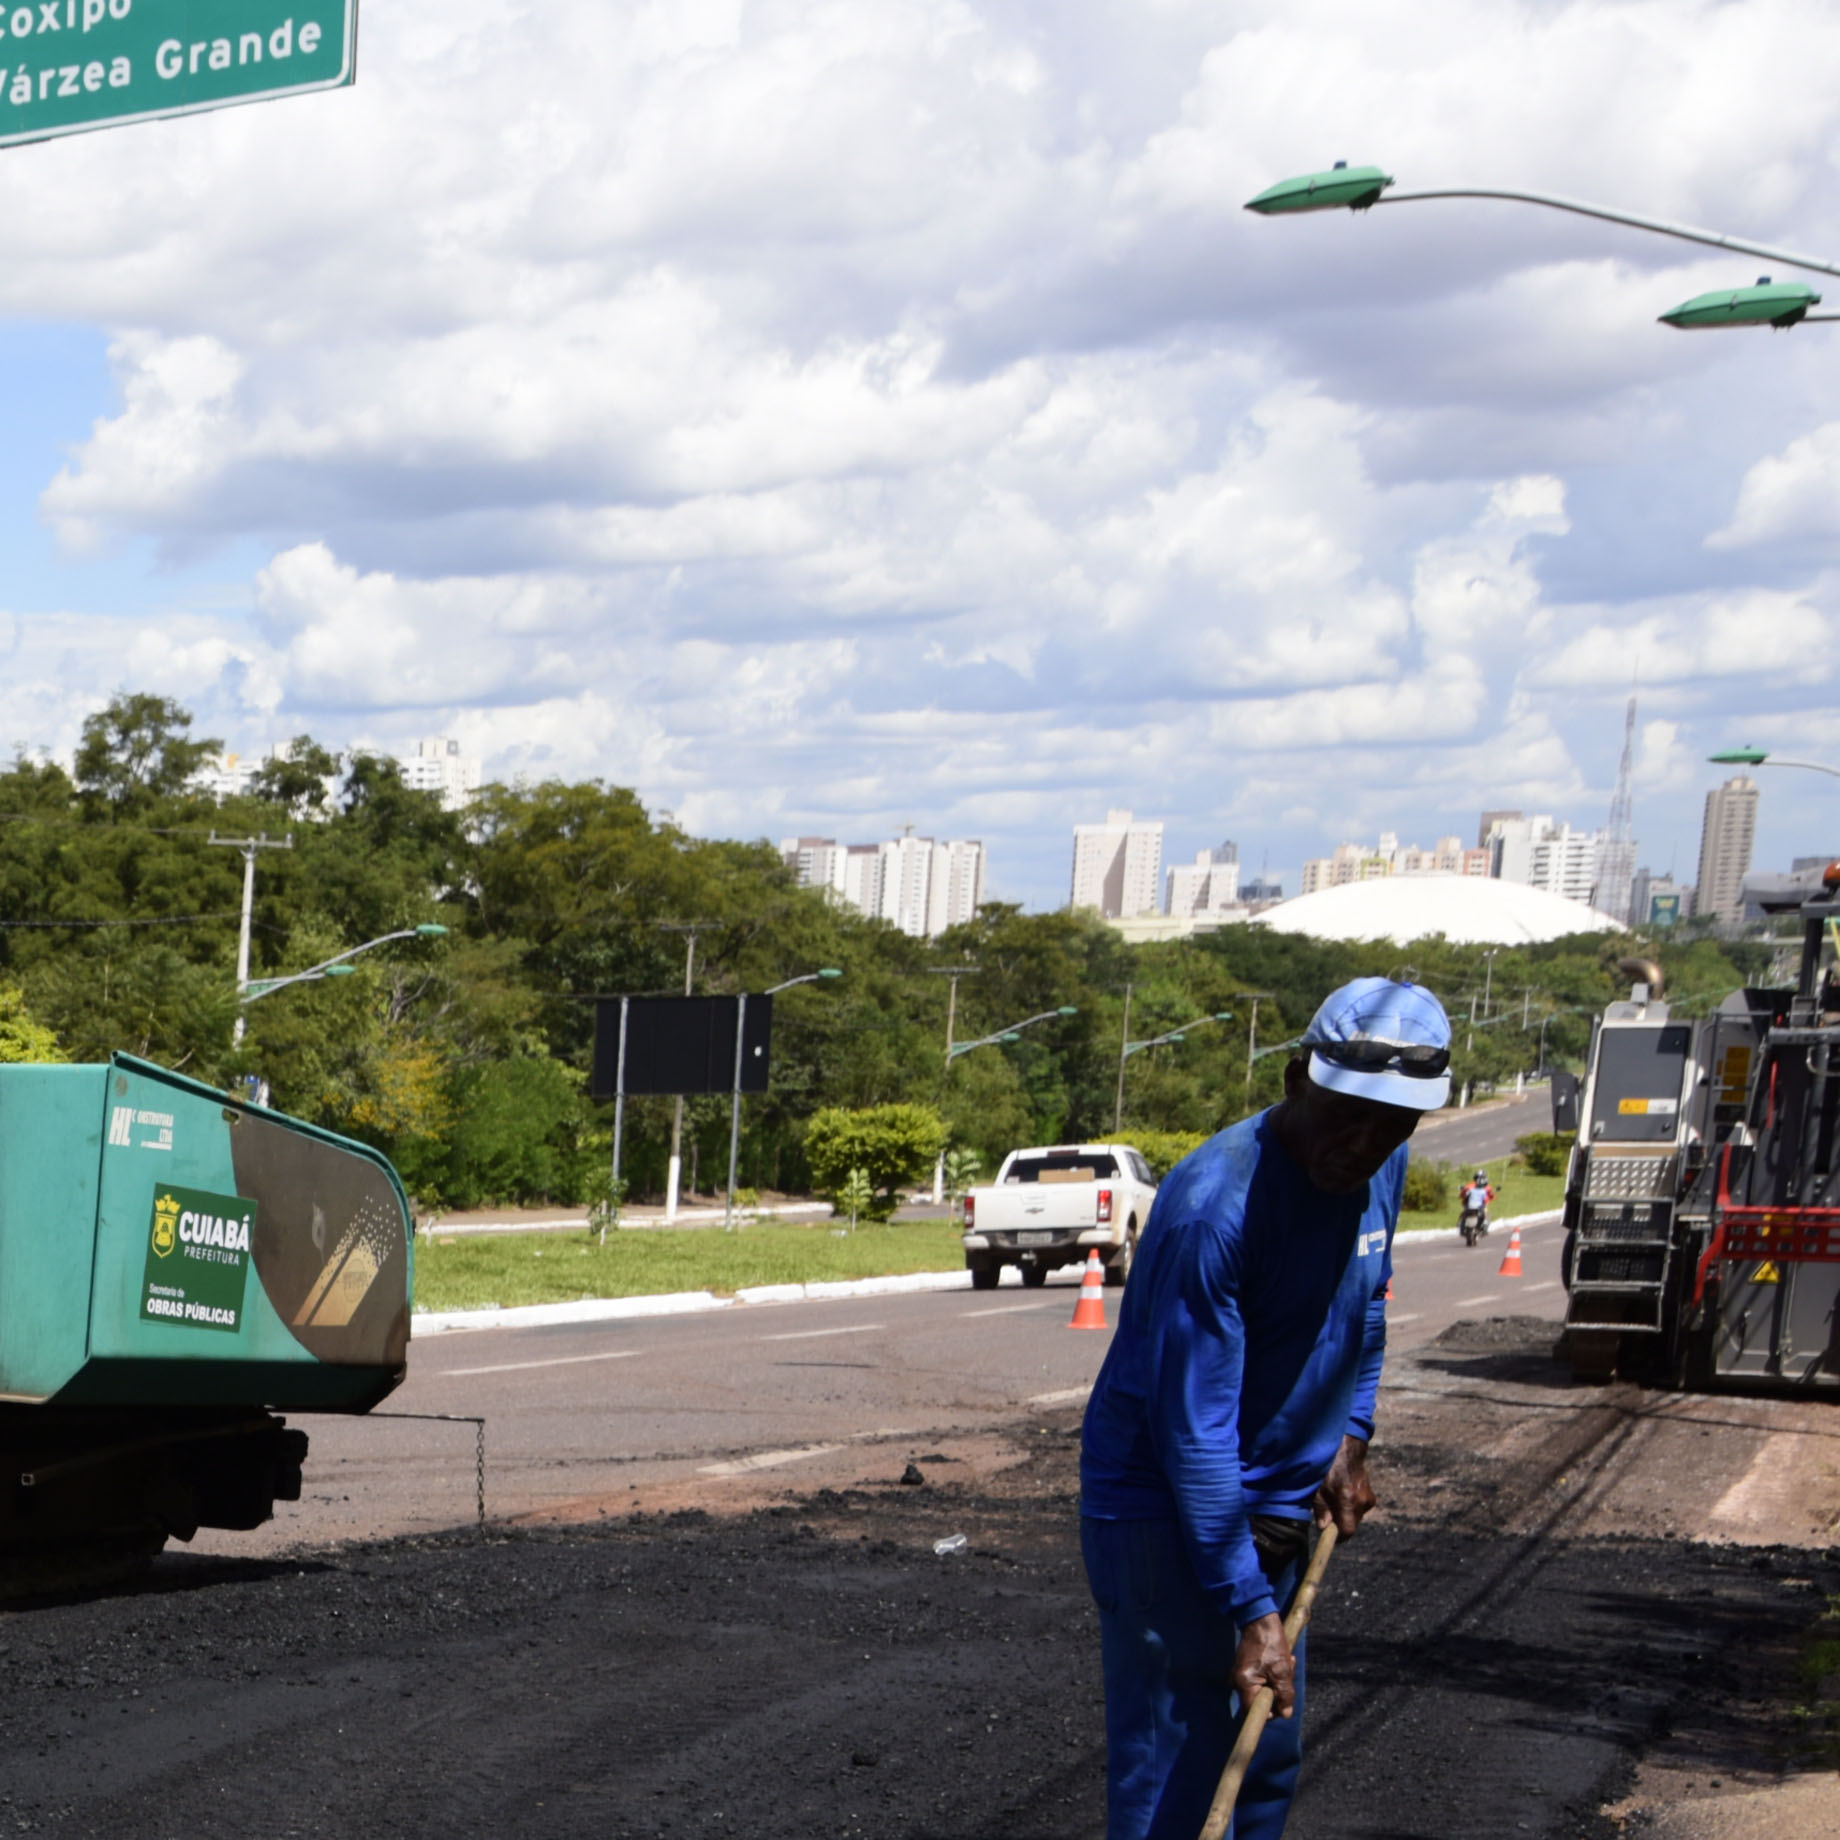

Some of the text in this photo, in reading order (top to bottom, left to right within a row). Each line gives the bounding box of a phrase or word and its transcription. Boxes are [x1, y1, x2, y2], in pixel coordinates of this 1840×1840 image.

[155, 18, 322, 80] Grande
[179, 1210, 251, 1252] CUIABÁ
[183, 1245, 240, 1266] PREFEITURA
[147, 1298, 236, 1325] OBRAS PÚBLICAS
